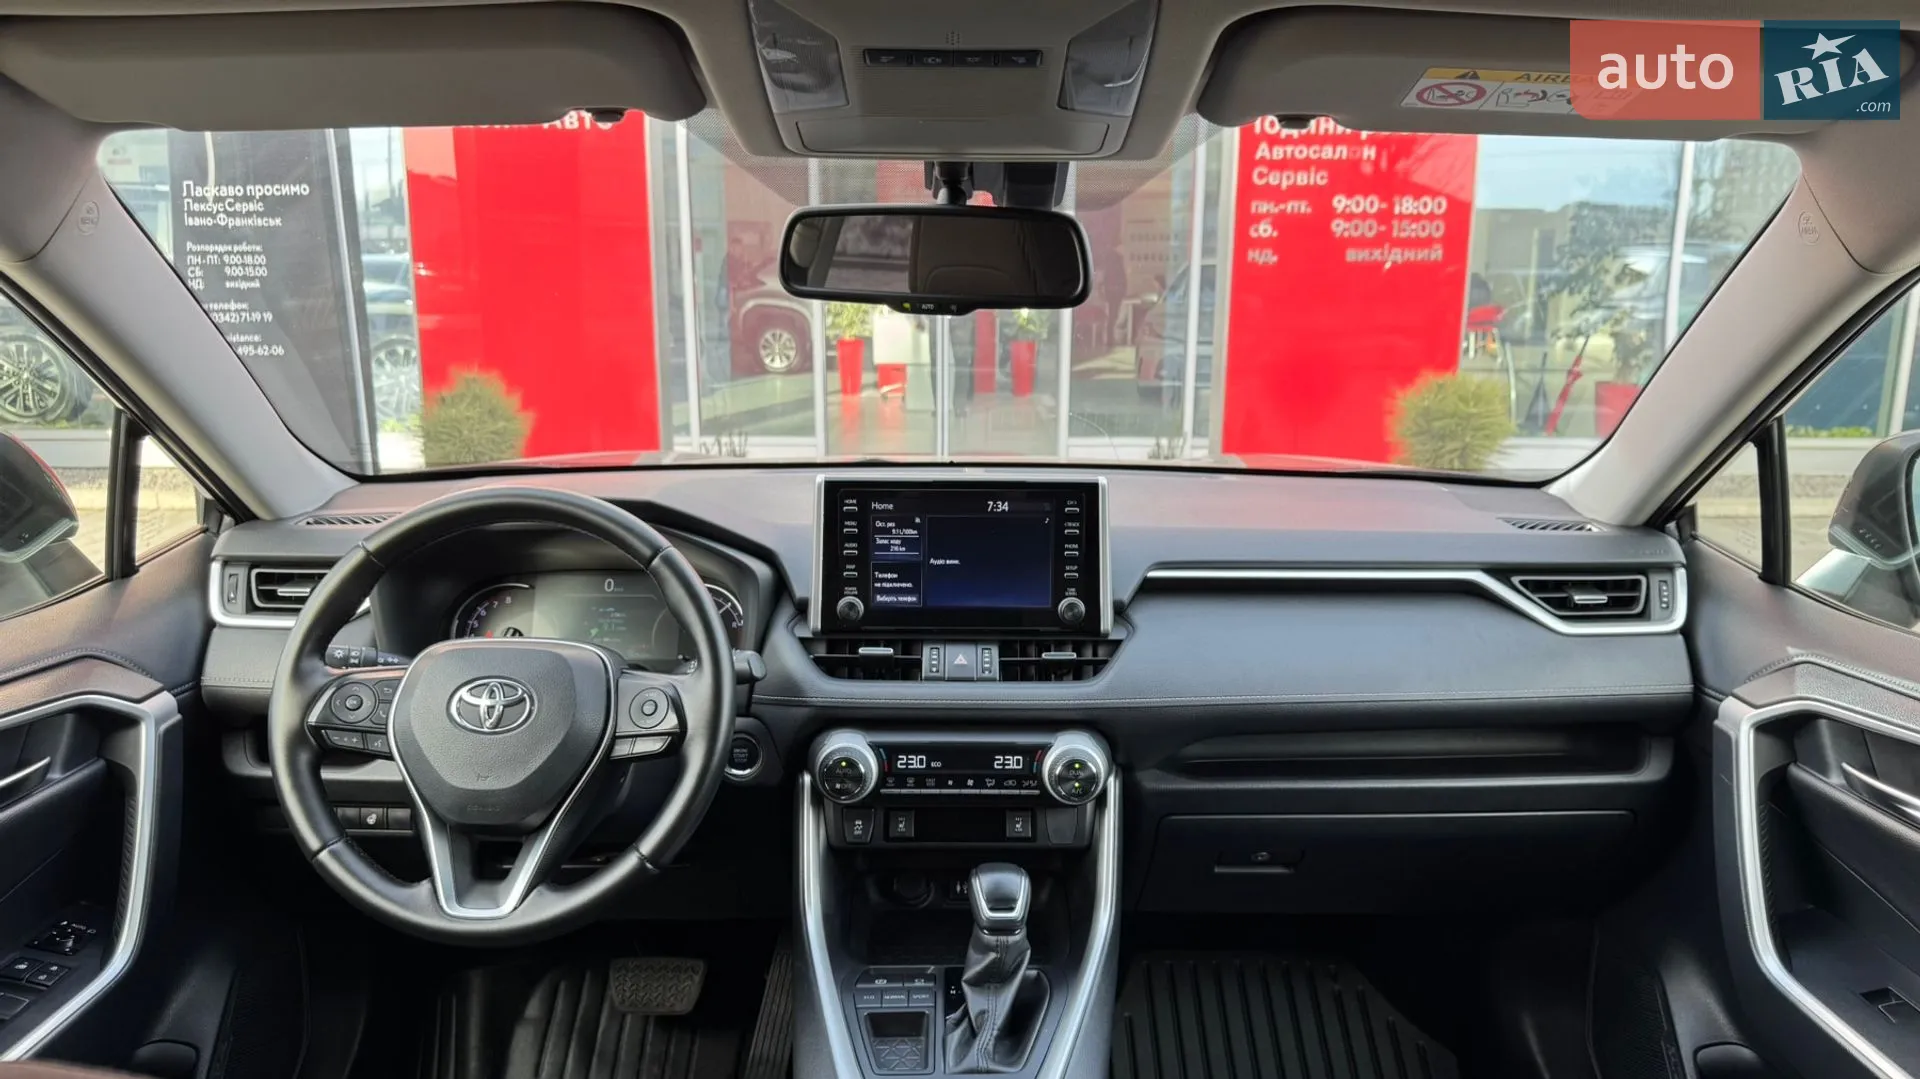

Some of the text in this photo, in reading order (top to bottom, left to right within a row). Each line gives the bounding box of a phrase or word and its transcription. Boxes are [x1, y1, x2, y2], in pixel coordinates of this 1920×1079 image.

[1252, 166, 1328, 190] Сервіс
[246, 183, 310, 200] просимо
[184, 213, 282, 229] Івано-Франківськ
[1249, 218, 1279, 238] сб.
[1345, 244, 1443, 265] вихідний
[871, 501, 1009, 513] Home 7:34
[604, 578, 614, 592] 0
[480, 608, 487, 616] 6
[897, 755, 926, 769] 23.0
[993, 755, 1023, 769] 23.0
